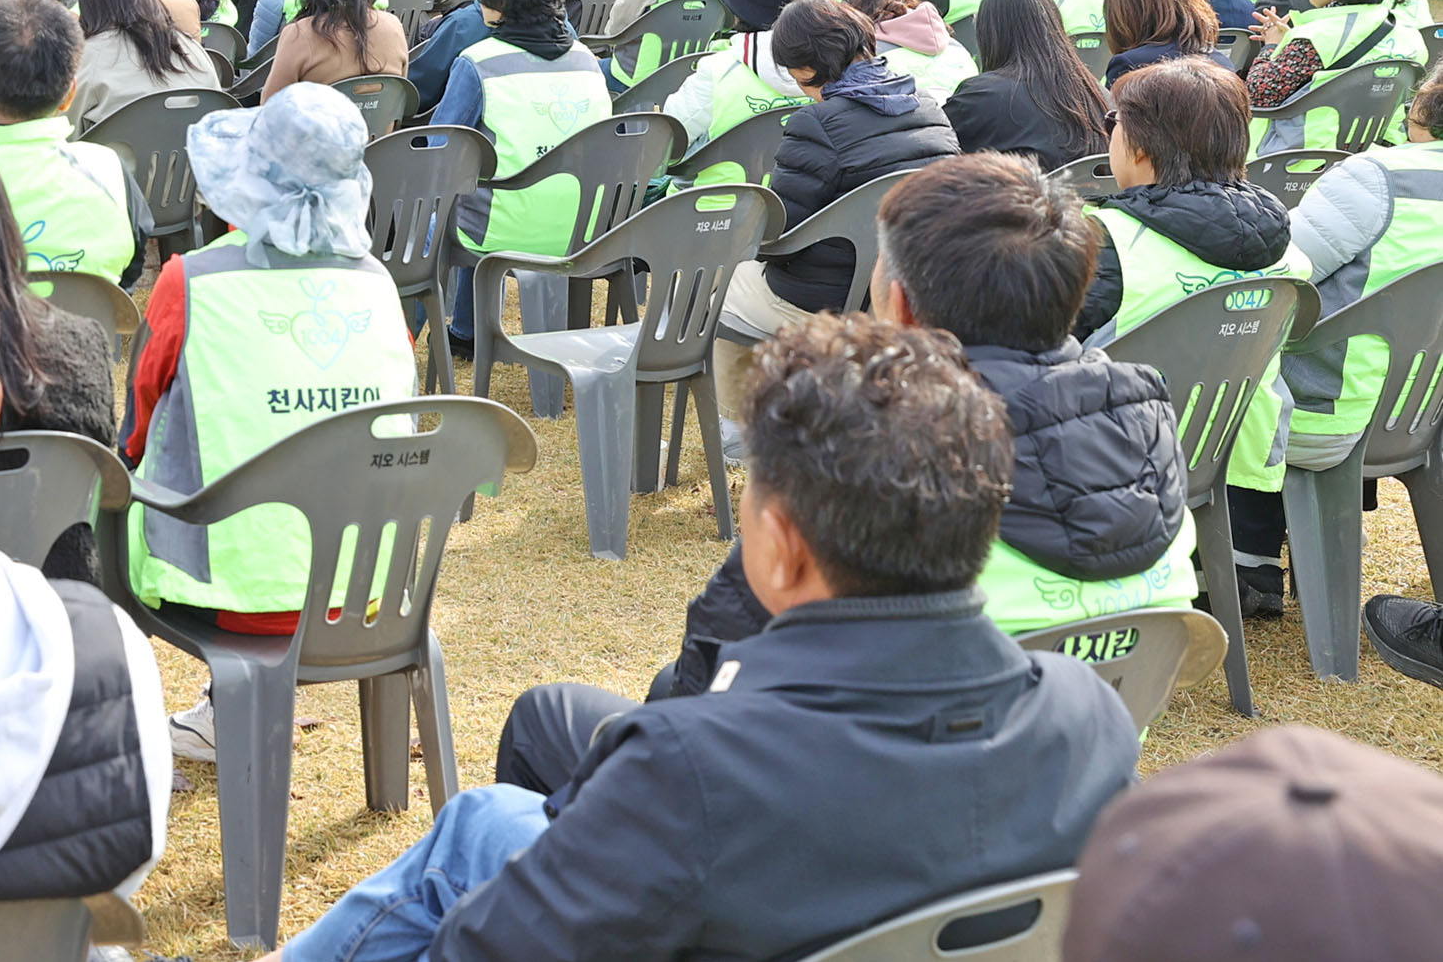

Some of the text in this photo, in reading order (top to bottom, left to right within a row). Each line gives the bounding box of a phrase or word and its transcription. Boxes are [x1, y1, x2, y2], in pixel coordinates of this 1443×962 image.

[364, 100, 379, 109] 시스템
[1284, 181, 1312, 192] 지오 시스
[695, 218, 731, 234] 지오 시스템
[1218, 319, 1261, 336] 지오 시스템
[370, 448, 430, 469] 지오 시스템
